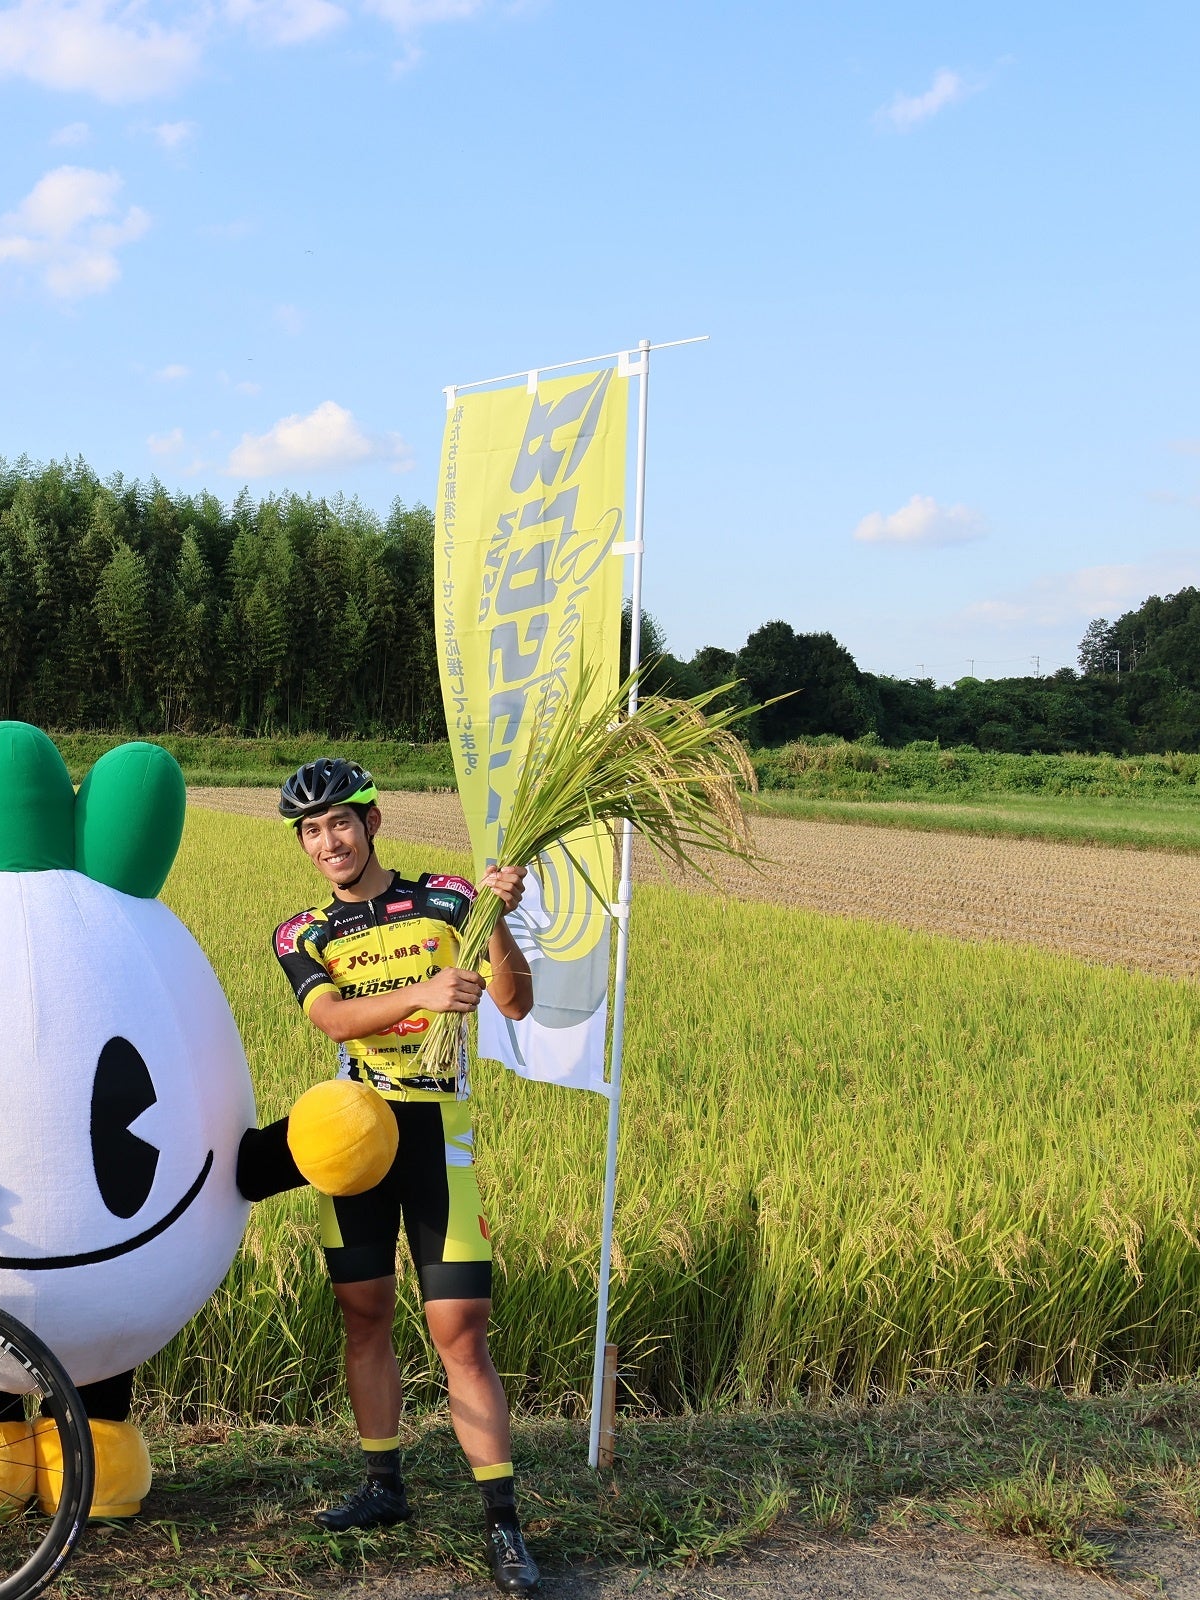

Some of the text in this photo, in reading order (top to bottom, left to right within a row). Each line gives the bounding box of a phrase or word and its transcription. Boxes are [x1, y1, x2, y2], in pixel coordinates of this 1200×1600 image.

[430, 898, 455, 911] Grandy
[342, 914, 364, 923] ASHIMO
[347, 944, 421, 970] パリッと朝食
